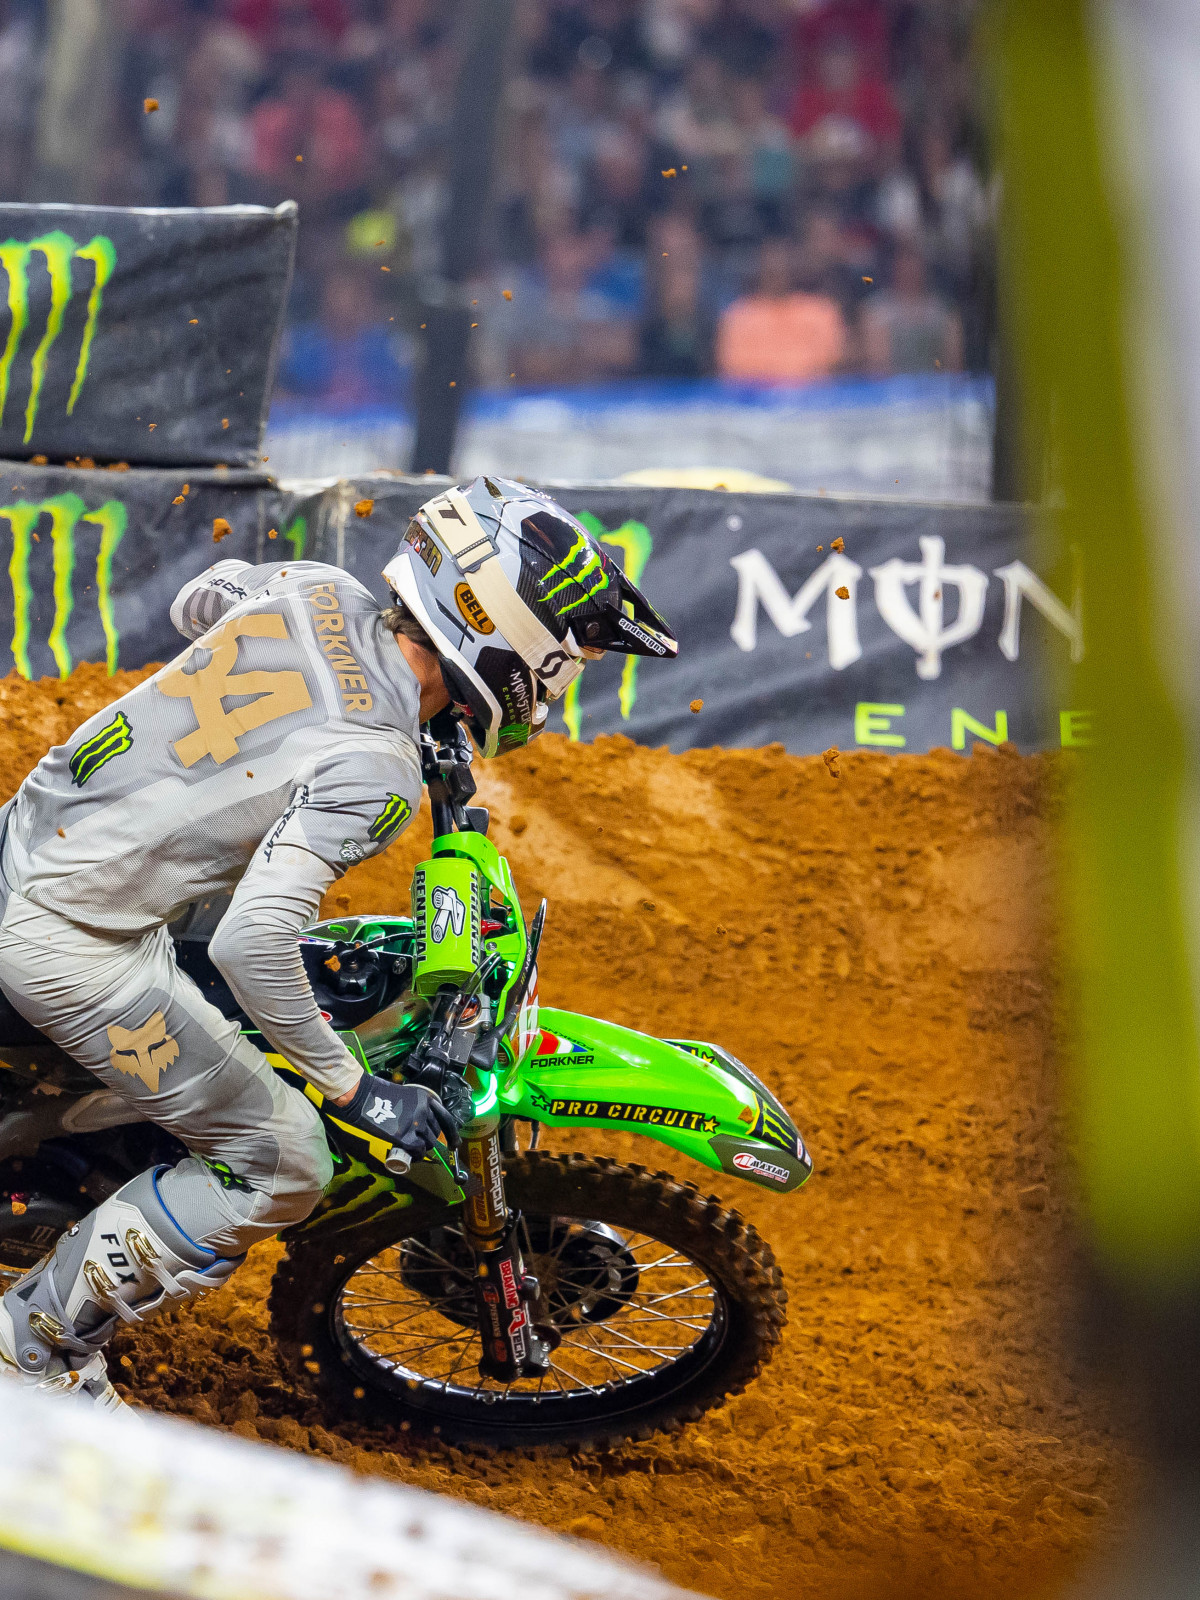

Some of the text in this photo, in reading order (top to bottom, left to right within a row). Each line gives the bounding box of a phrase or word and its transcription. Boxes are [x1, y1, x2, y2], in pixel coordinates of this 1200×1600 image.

[460, 589, 489, 630] BELL
[307, 581, 373, 714] FORKNER
[618, 618, 666, 655] apdesigns
[530, 1055, 595, 1068] FORKNER
[551, 1100, 703, 1129] PRO CIRCUIT
[487, 1134, 505, 1217] PRO CIRCUIT
[100, 1233, 141, 1285] FOX
[500, 1260, 519, 1309] BRAKING
